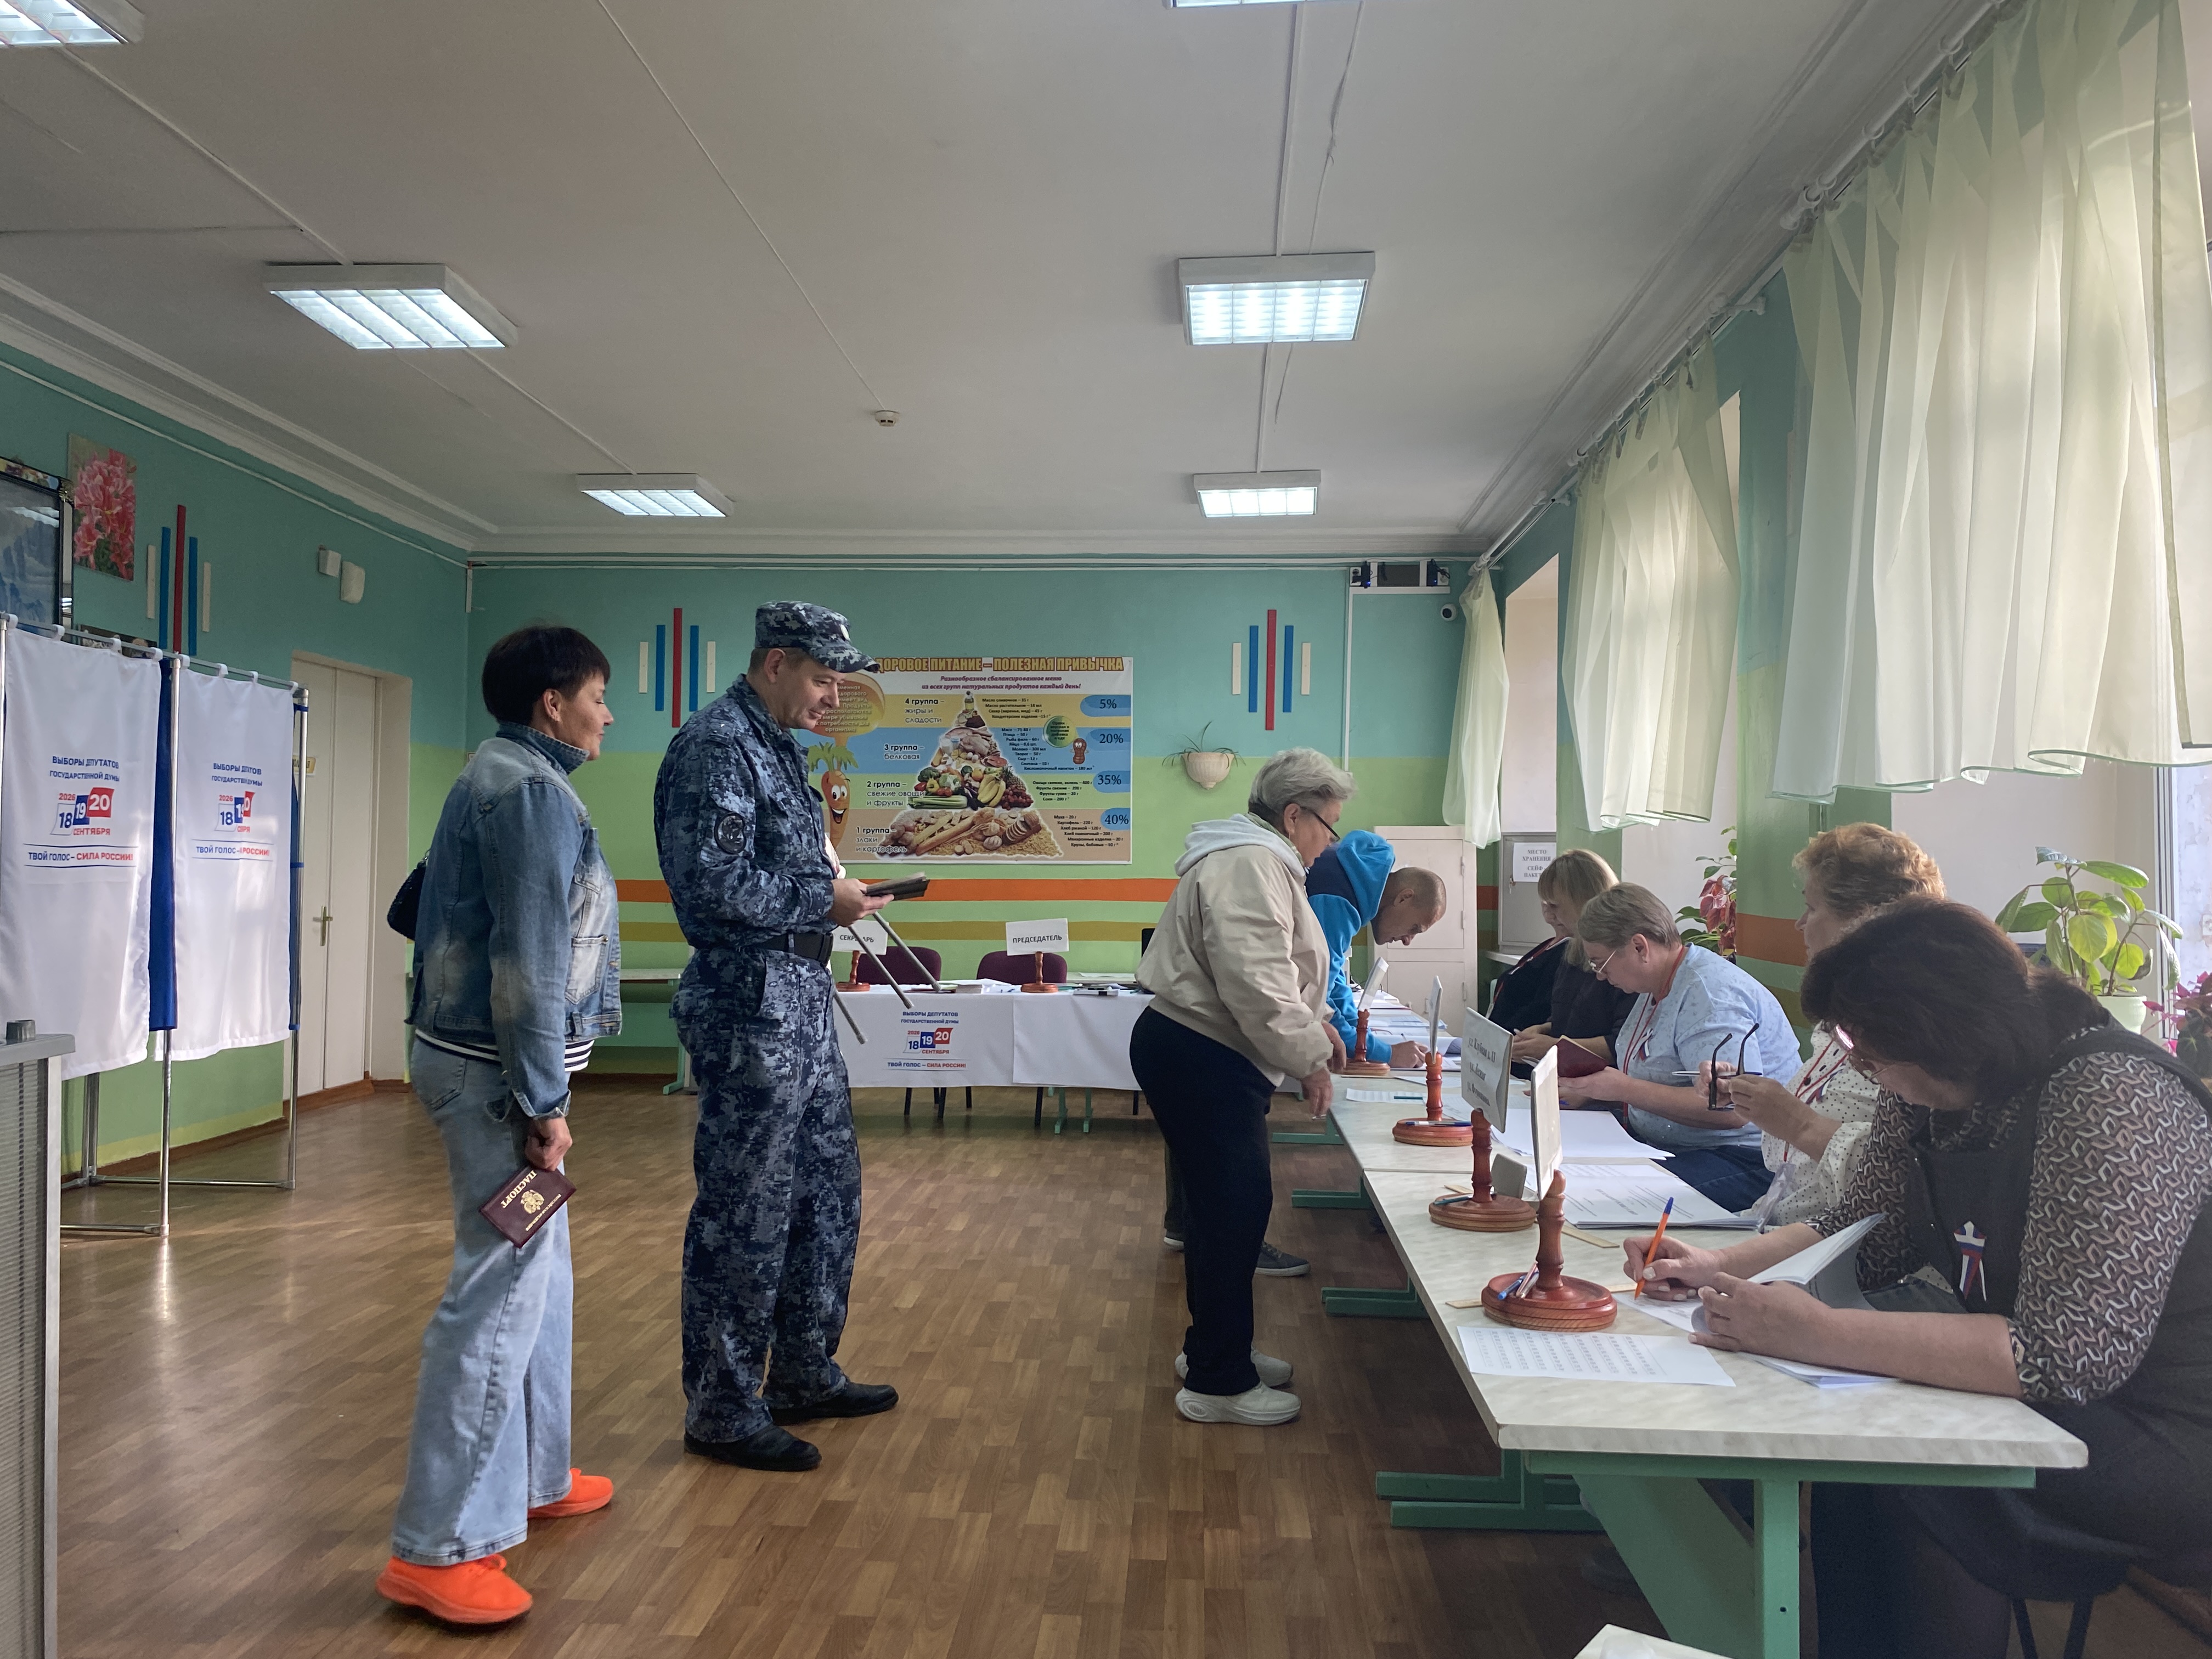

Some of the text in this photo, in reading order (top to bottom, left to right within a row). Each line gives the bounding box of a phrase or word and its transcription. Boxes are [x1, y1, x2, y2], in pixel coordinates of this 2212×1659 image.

[877, 657, 1124, 673] ДОРОВОЕ ПИТАНИЕ ПОЛЕЗНАЯ ПРИВЫЧКА
[1099, 699, 1117, 709] 5%
[1099, 733, 1124, 743] 20%
[52, 756, 84, 766] ВЫБОРЫ
[213, 763, 240, 771] ВЫБОРЫ
[104, 774, 120, 782] ДУМЫ
[1098, 775, 1121, 785] 35%
[59, 793, 76, 801] 2026
[59, 794, 110, 828] 18 19 20
[221, 811, 234, 826] 18
[244, 797, 250, 811] 0
[1104, 815, 1129, 825] 40%
[196, 845, 213, 854] ТВОЙ
[243, 848, 269, 856] РОССИИ!
[29, 851, 48, 860] ТВОЙ
[101, 853, 133, 861] РОССИИ!
[839, 934, 874, 943] СЕКРАРЬ
[1012, 935, 1062, 944] ПРЕДСЕДАТЕЛЬ
[909, 1031, 949, 1049] 18 19 20
[500, 1170, 538, 1209] ПАСПОРТ
